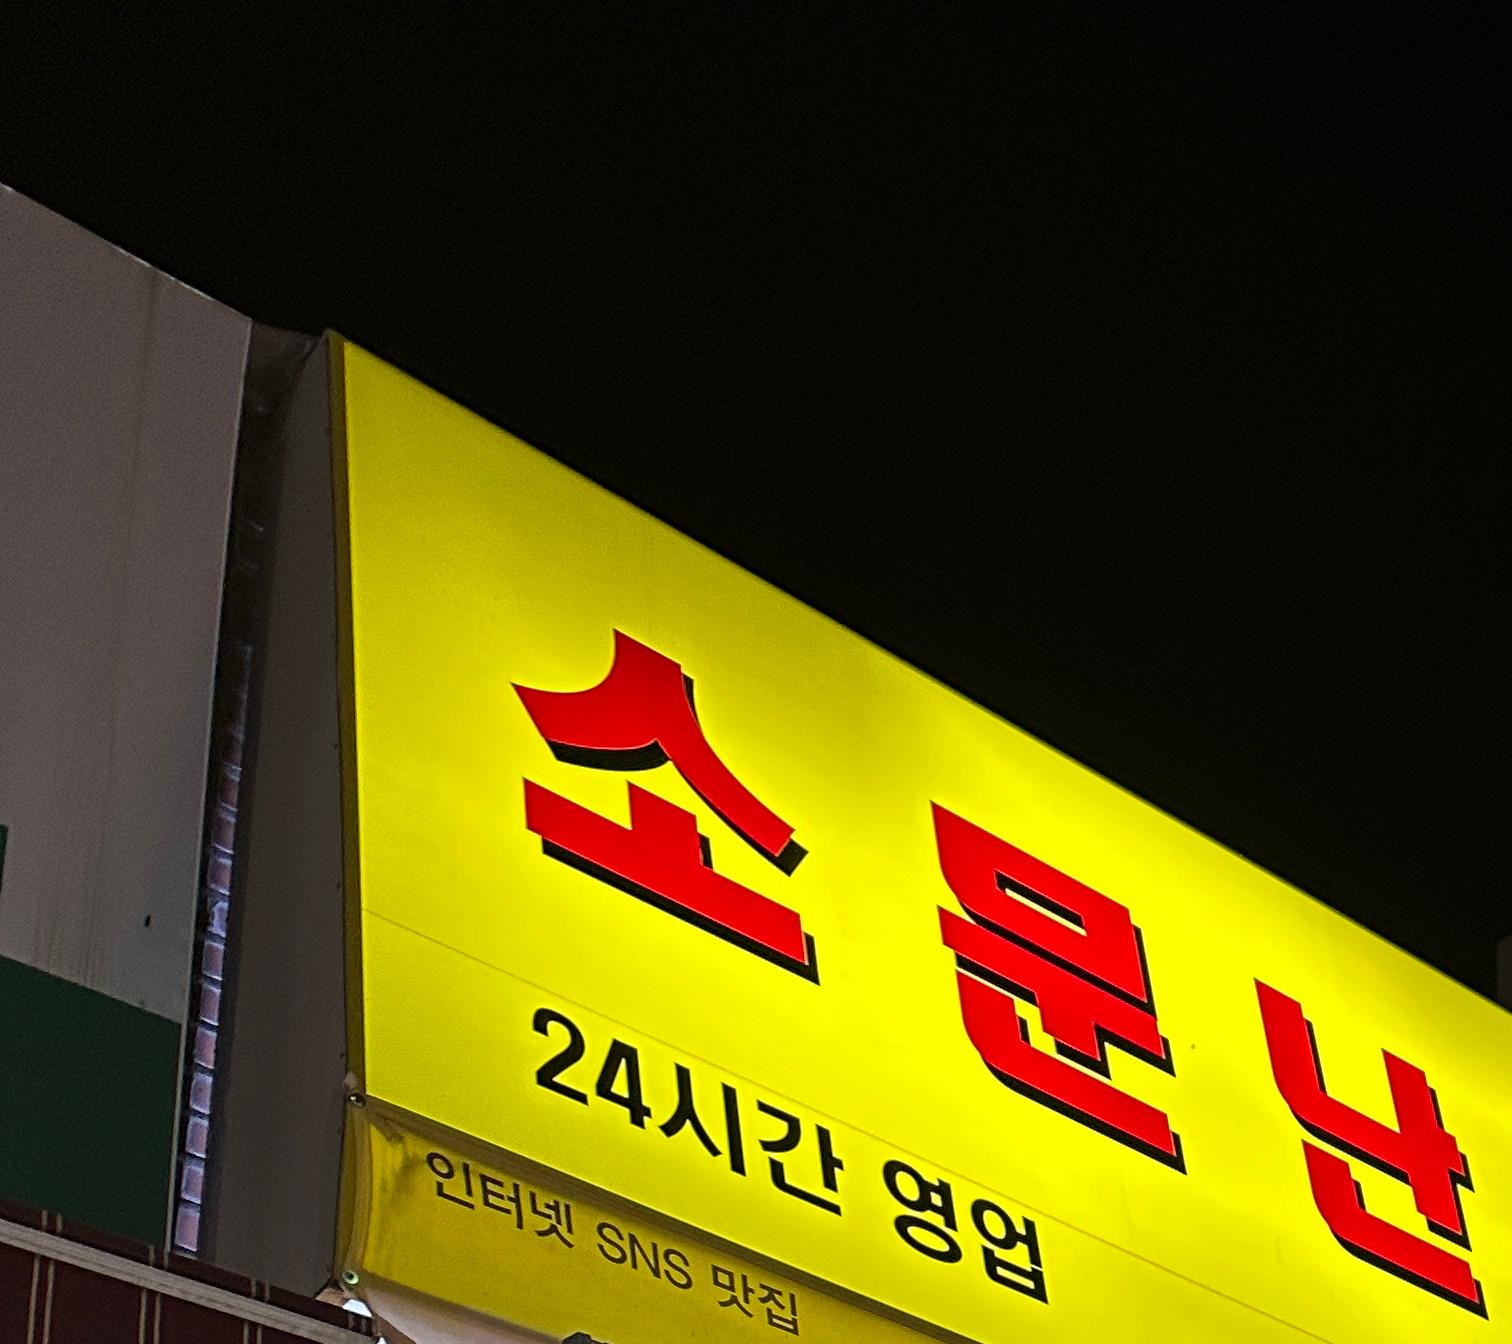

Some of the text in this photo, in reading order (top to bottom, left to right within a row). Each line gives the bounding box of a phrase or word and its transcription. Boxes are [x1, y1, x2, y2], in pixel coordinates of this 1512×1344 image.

[425, 1150, 802, 1337] 인터넷 SNS 맛집
[531, 1007, 1049, 1305] 24시간 영업
